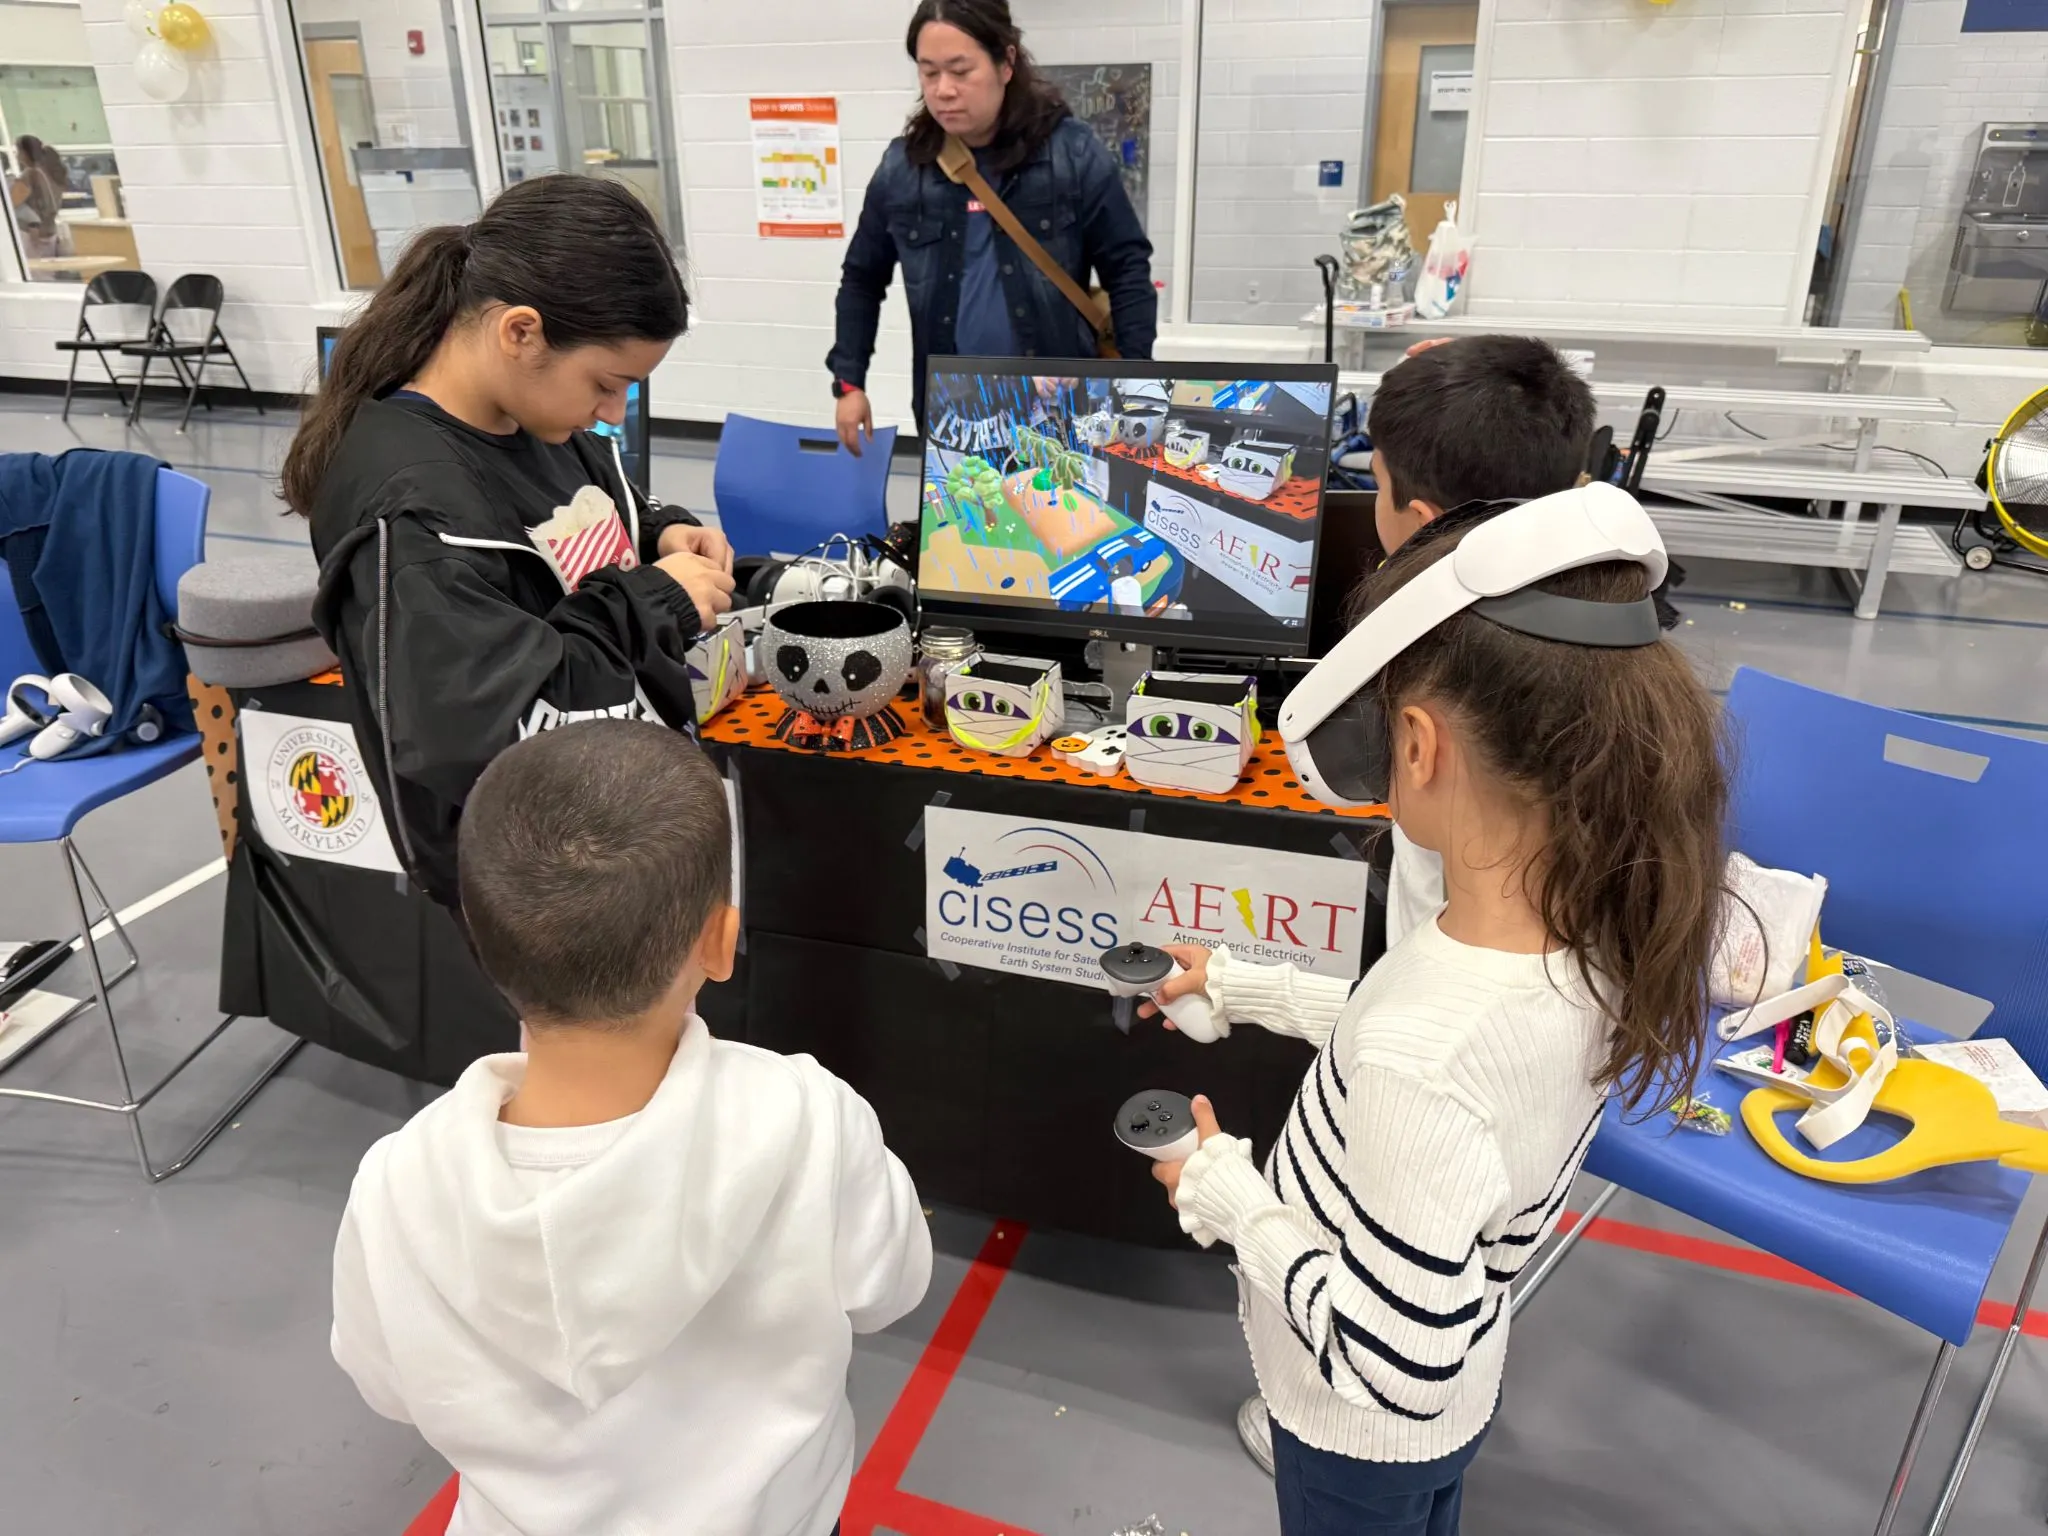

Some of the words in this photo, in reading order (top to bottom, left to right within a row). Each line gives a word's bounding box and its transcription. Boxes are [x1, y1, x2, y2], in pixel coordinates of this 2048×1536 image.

[274, 731, 348, 767] UNIVERSITY
[349, 757, 364, 778] OF
[278, 807, 366, 850] MARYLAND
[940, 932, 1005, 951] Cooperative
[1006, 942, 1052, 961] Institute
[1053, 949, 1071, 962] for
[1253, 943, 1317, 968] Electricity
[1000, 955, 1029, 970] Earth
[1031, 961, 1072, 978] System
